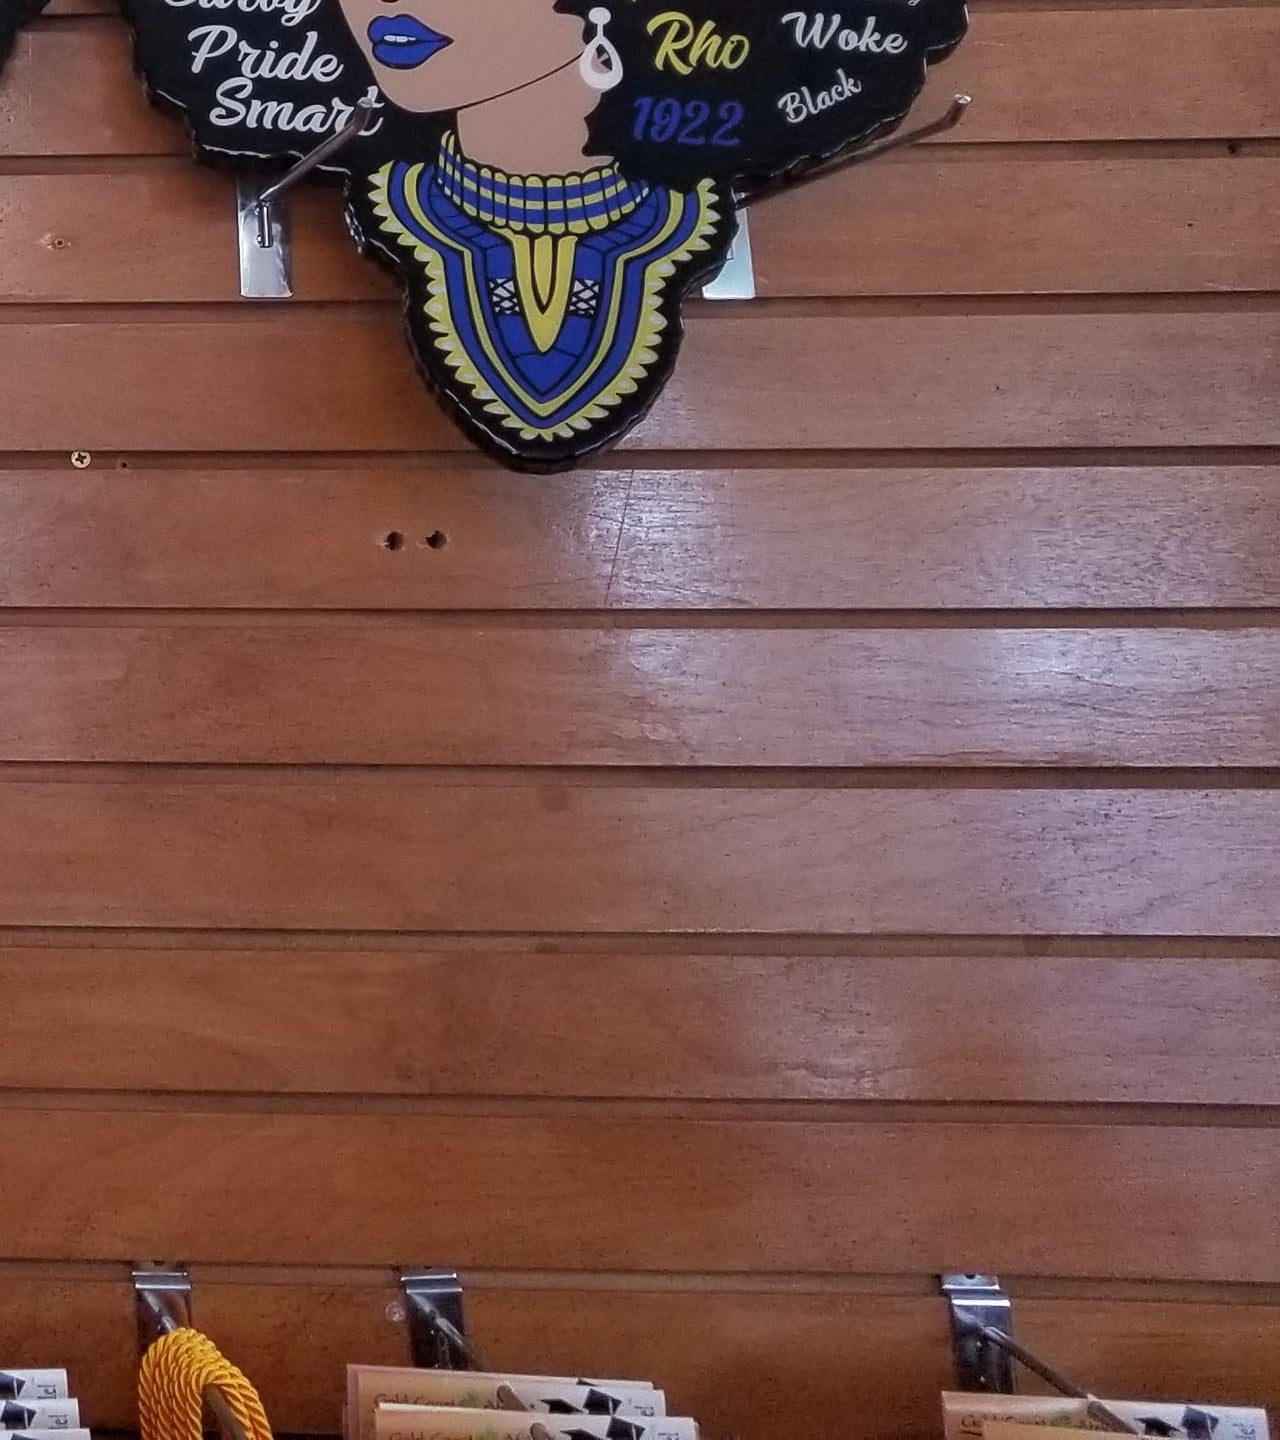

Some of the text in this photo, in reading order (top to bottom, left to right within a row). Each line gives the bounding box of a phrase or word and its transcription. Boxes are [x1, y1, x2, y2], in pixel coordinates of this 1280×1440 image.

[188, 25, 344, 82] Pride
[647, 12, 749, 74] Rho
[781, 12, 907, 53] Woke
[634, 97, 743, 145] 1922
[778, 68, 861, 123] Black
